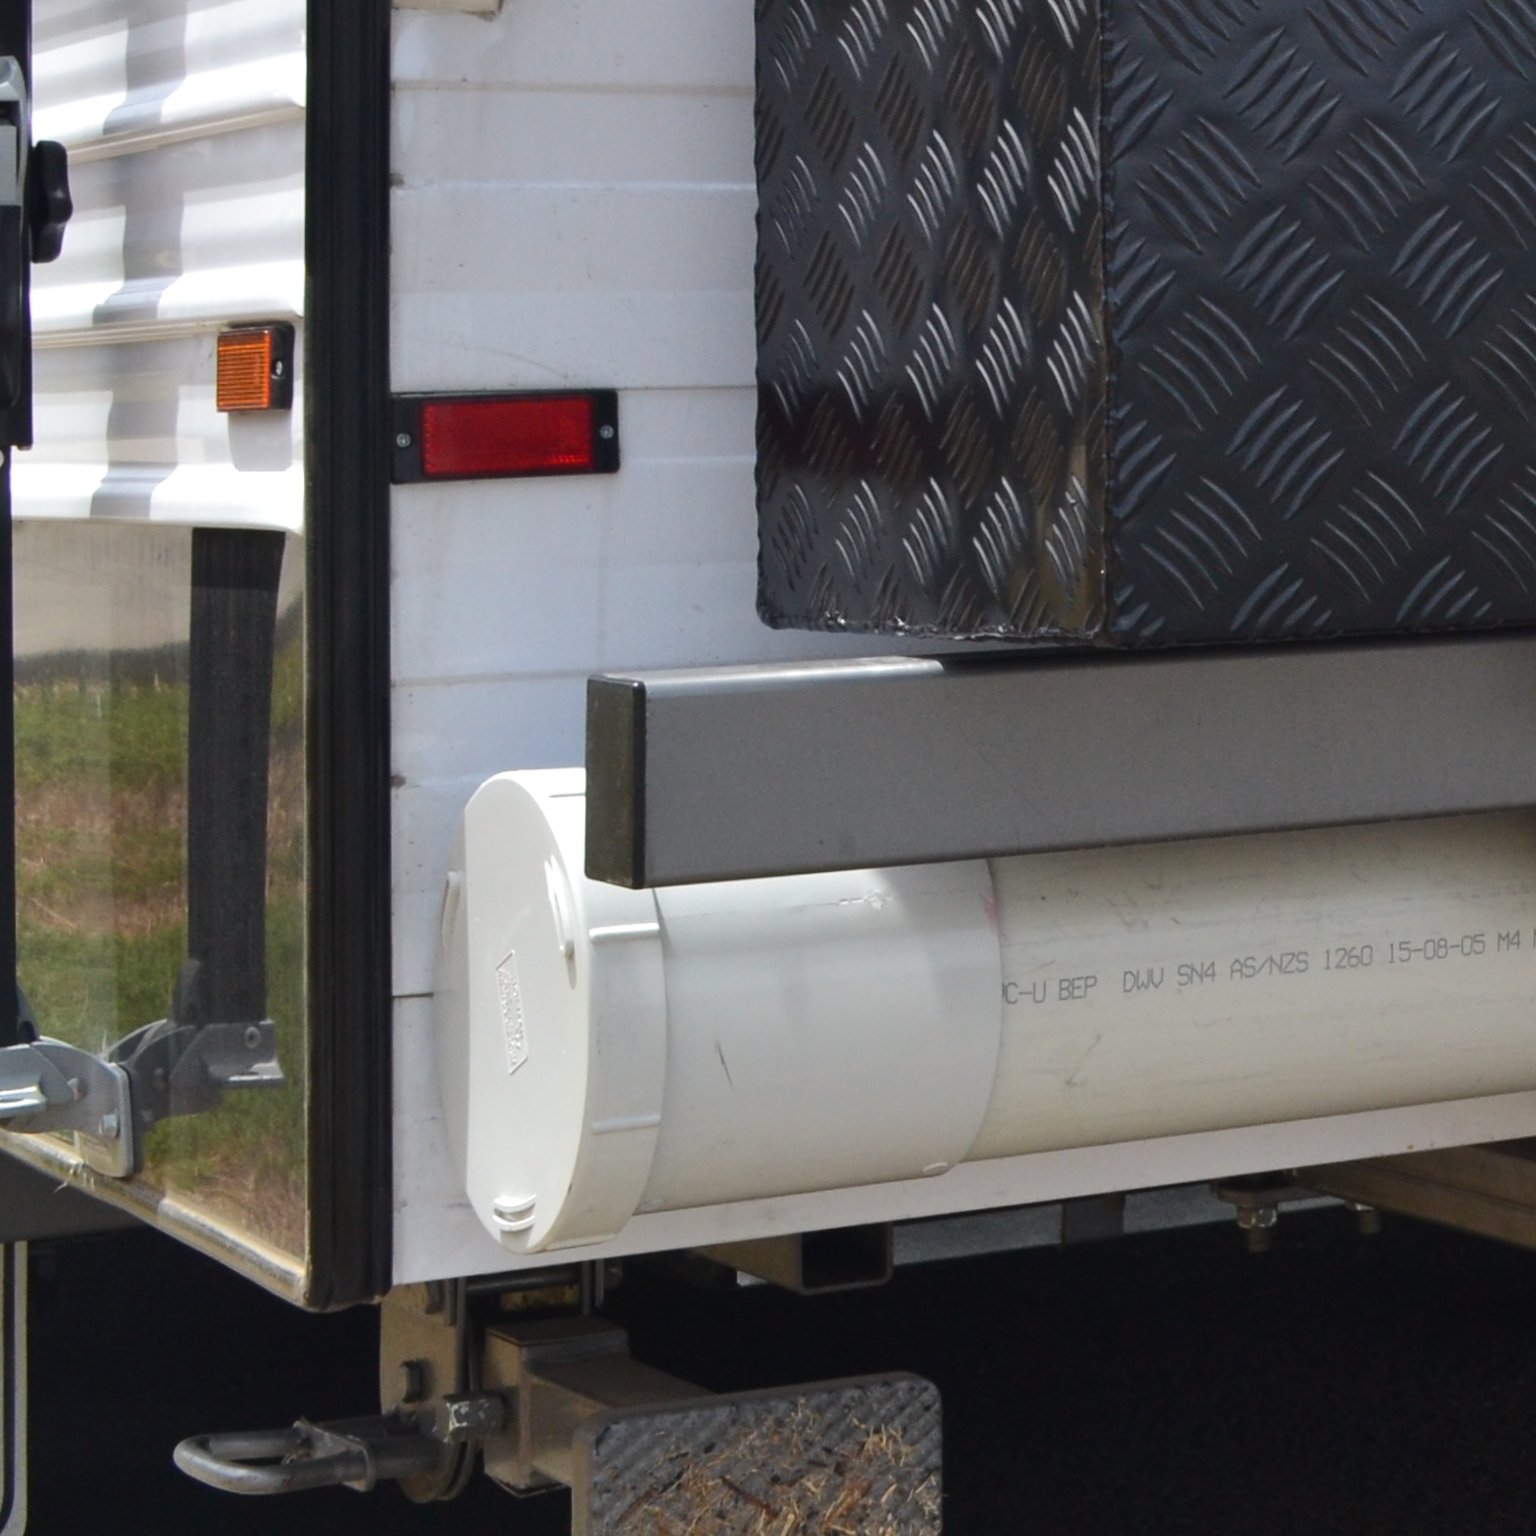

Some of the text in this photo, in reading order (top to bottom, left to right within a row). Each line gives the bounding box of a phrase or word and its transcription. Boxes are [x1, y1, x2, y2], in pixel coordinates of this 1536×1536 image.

[1058, 975, 1098, 1002] BEP
[1122, 967, 1165, 993] DWV
[1177, 961, 1217, 986] SN4
[1229, 952, 1310, 981] AS/NZS
[1323, 944, 1374, 972] 1260
[1387, 934, 1486, 965] 15-08-05
[1496, 930, 1522, 951] M4
